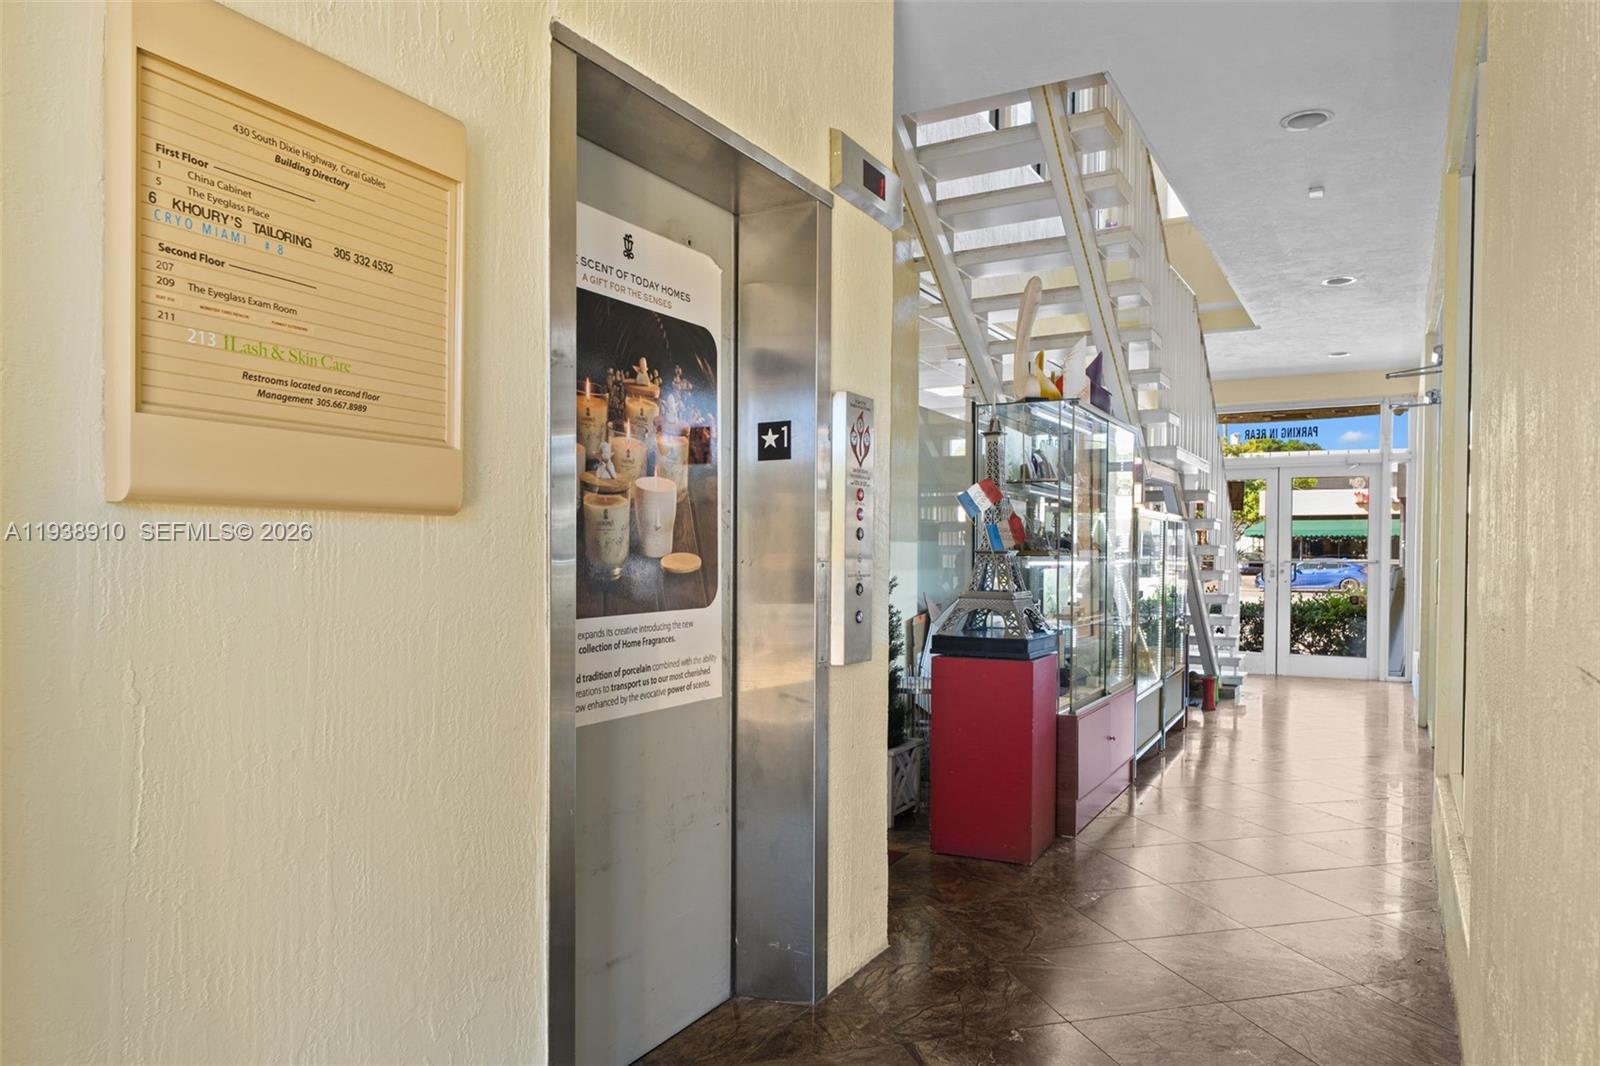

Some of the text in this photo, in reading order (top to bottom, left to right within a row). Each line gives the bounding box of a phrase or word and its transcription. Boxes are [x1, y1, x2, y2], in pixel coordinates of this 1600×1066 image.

[155, 143, 209, 169] First Floor
[232, 124, 386, 189] 430 South Dixie Highway, Coral Gables
[157, 160, 252, 199] 1 China Cabinet
[274, 154, 350, 190] Building Directory
[156, 177, 270, 219] 5 The Eyeglass Place
[148, 191, 394, 274] 6 KHOURY'S TAILORING 305 332 4532
[153, 208, 193, 230] CRYO
[202, 223, 247, 245] MIAMI
[277, 244, 284, 255] 8
[156, 260, 174, 272] 207
[158, 242, 225, 267] Second Floor
[580, 256, 614, 275] SCENT
[616, 269, 629, 280] OF
[631, 274, 660, 291] TODAY
[661, 285, 691, 303] HOMES
[582, 273, 672, 309] A GIFT FOR THE SENSES
[156, 275, 298, 316] 209 The Eyeglass Exam Room
[157, 310, 175, 321] 211
[187, 328, 217, 348] 213
[271, 345, 284, 361] &
[288, 349, 317, 367] Skin
[321, 354, 352, 373] Care
[242, 371, 380, 401] Restrooms located on second floor
[257, 389, 367, 413] Management 305.667.8989
[781, 425, 788, 447] 1
[577, 629, 605, 641] expands
[615, 625, 638, 636] creative
[639, 622, 671, 633] introducing
[672, 621, 681, 629] the
[578, 635, 676, 654] collection of Home Fragrances.
[582, 671, 612, 683] tradition
[613, 667, 621, 678] of
[622, 664, 652, 678] porcelain
[652, 660, 680, 672] combined
[681, 656, 693, 666] with
[693, 656, 702, 664] the
[702, 654, 717, 664] ability
[602, 685, 610, 693] to
[611, 679, 641, 692] transport
[642, 678, 650, 686] us
[650, 676, 658, 685] to
[658, 675, 669, 683] our
[669, 672, 683, 682] most
[684, 666, 711, 679] cherished
[587, 697, 619, 711] enhanced
[620, 696, 627, 706] by
[628, 693, 639, 702] the
[640, 689, 666, 700] evocative
[667, 685, 685, 696] power
[686, 681, 692, 690] of
